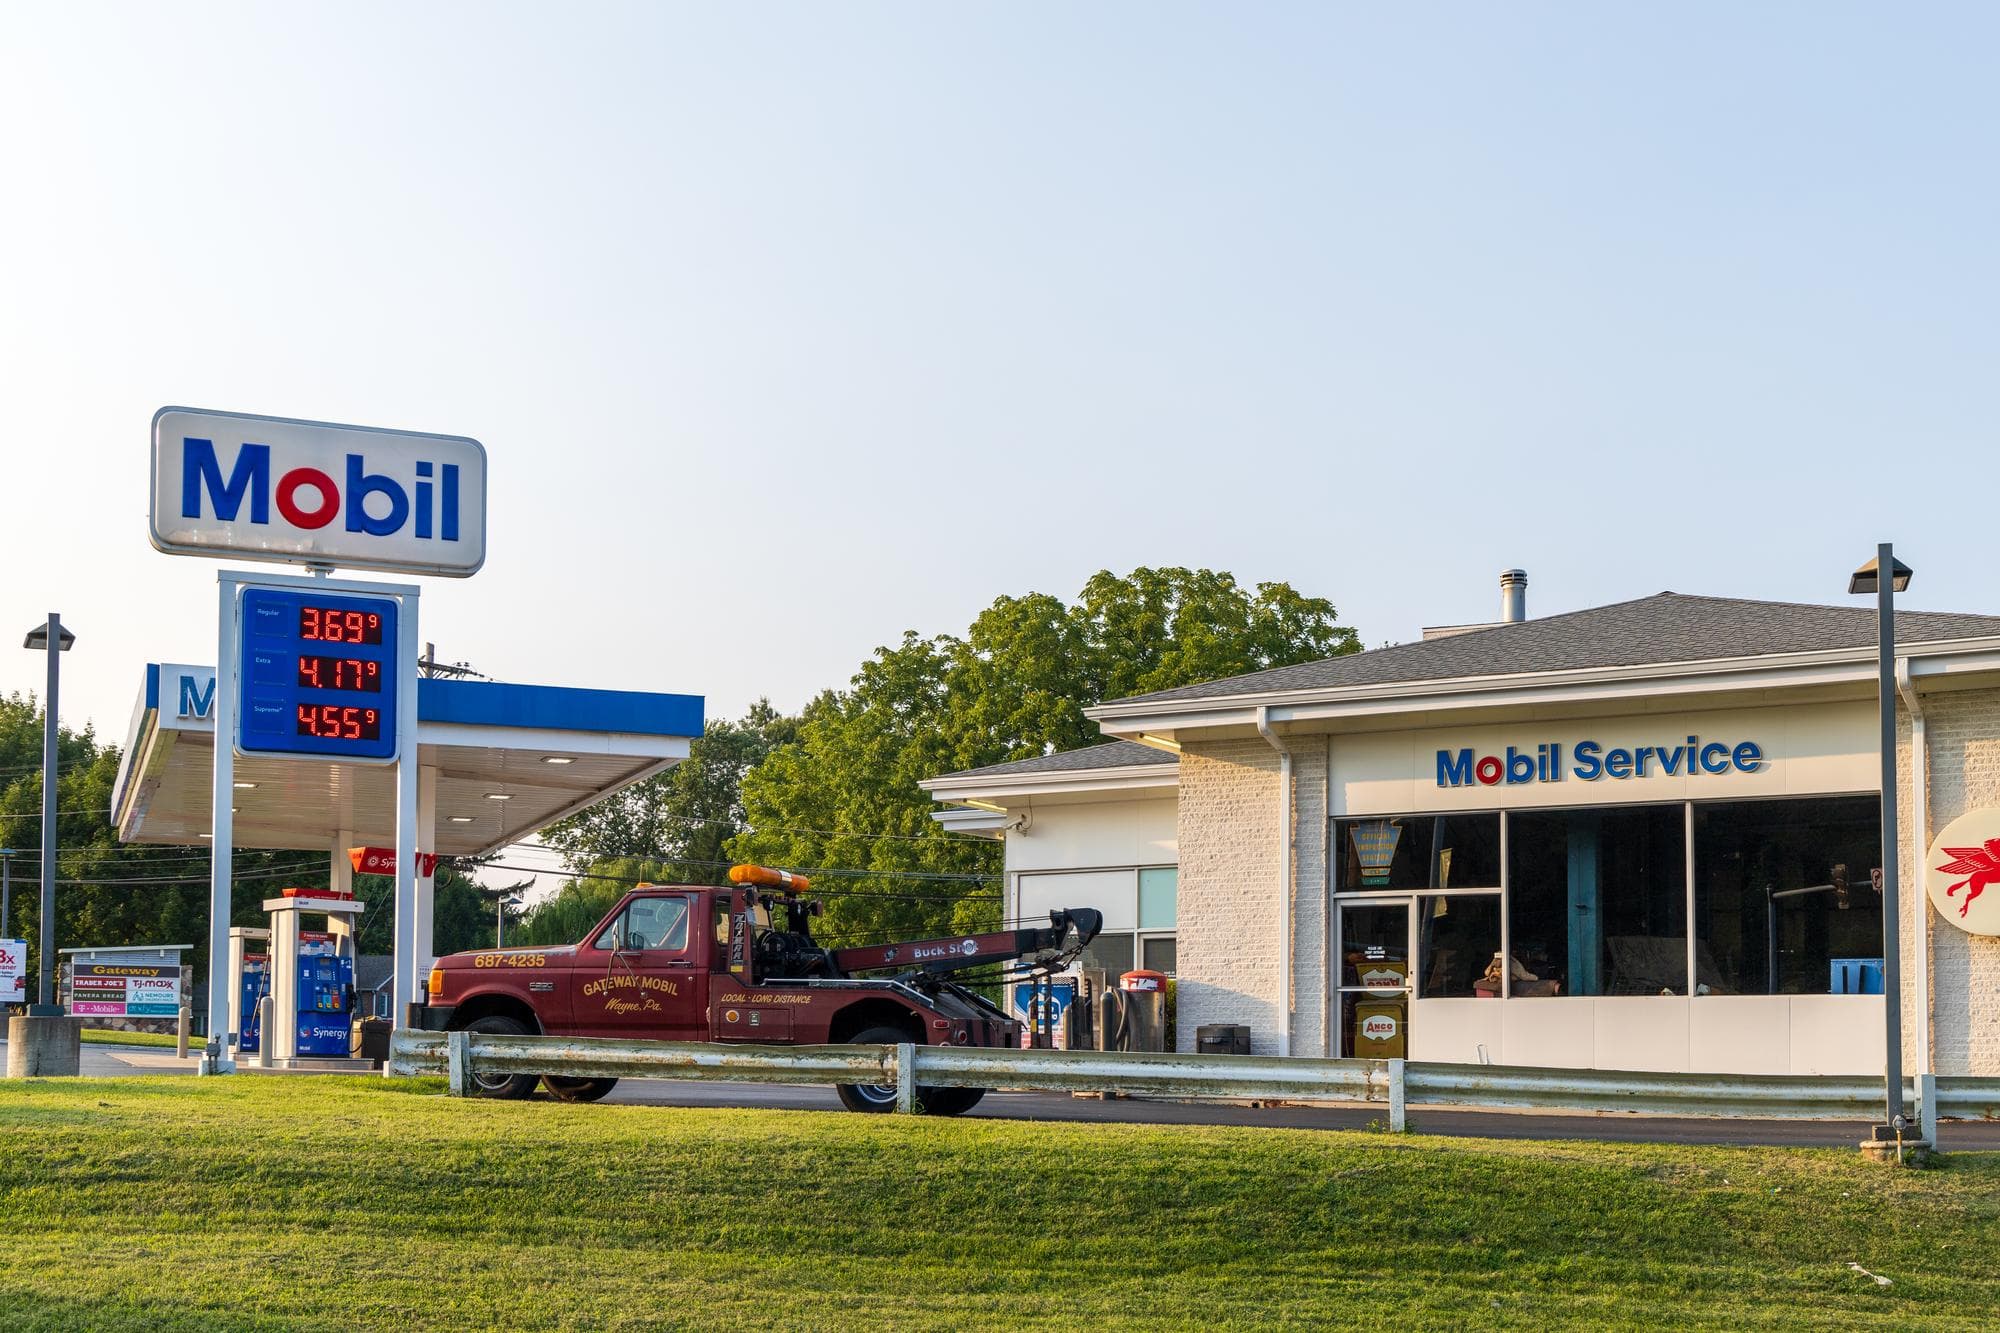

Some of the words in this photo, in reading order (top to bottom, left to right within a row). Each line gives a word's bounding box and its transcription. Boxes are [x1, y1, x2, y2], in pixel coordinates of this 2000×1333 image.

[182, 437, 459, 542] Mobil
[257, 608, 280, 617] Regular
[255, 656, 271, 664] Extra
[1436, 743, 1562, 786] Mobil
[1572, 735, 1764, 780] Service
[914, 946, 946, 958] Buck
[475, 954, 546, 968] 687-4235
[92, 965, 160, 977] Gateway
[583, 975, 639, 996] GATEWAY
[641, 976, 678, 996] MOBIL
[721, 993, 747, 1003] LOCAL
[751, 994, 773, 1003] LONG
[773, 995, 812, 1004] DISTANCE
[642, 999, 662, 1011] Pa.
[1366, 1021, 1393, 1033] ANCO
[313, 1027, 348, 1040] Synergy
